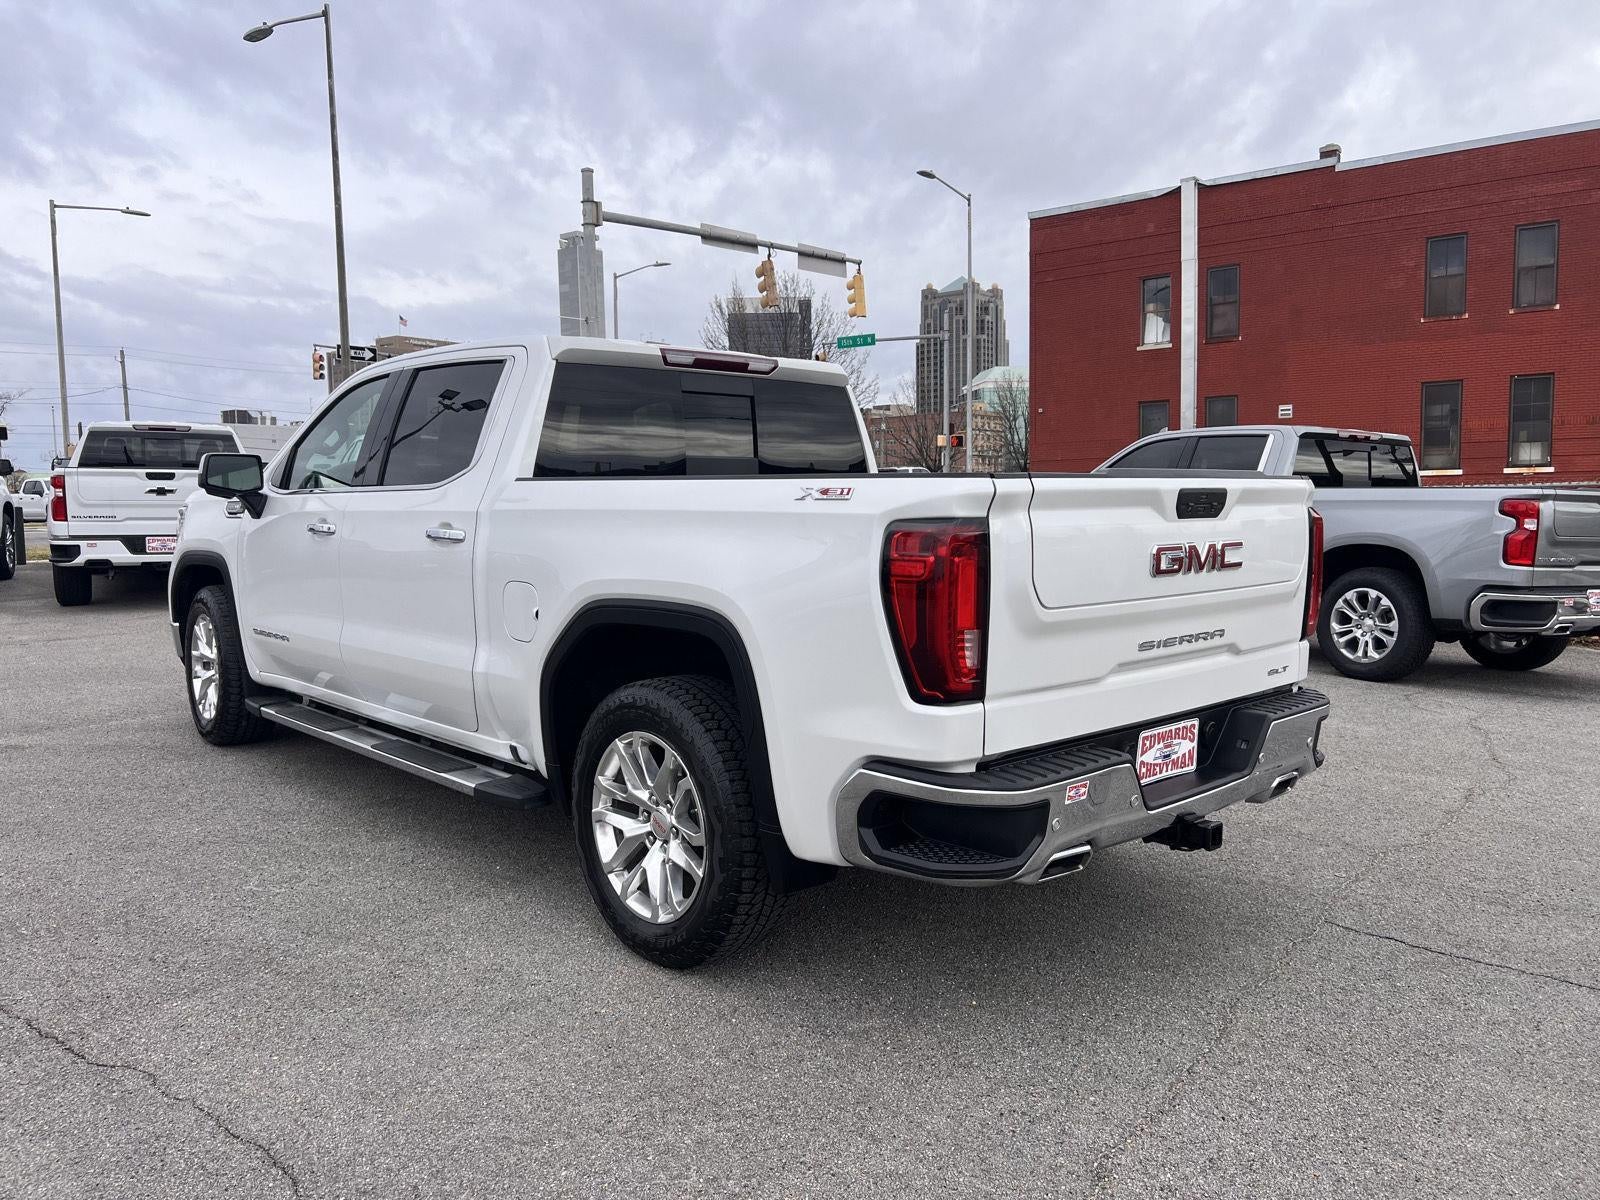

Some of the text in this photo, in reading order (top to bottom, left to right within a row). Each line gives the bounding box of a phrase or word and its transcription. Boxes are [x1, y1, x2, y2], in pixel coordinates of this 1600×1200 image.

[856, 337, 864, 345] St
[1150, 539, 1244, 578] GMC
[1137, 628, 1226, 652] SIERRA
[1267, 665, 1290, 677] SLT
[1140, 723, 1197, 757] EDWARDS
[1138, 746, 1195, 781] CHEVYMAN
